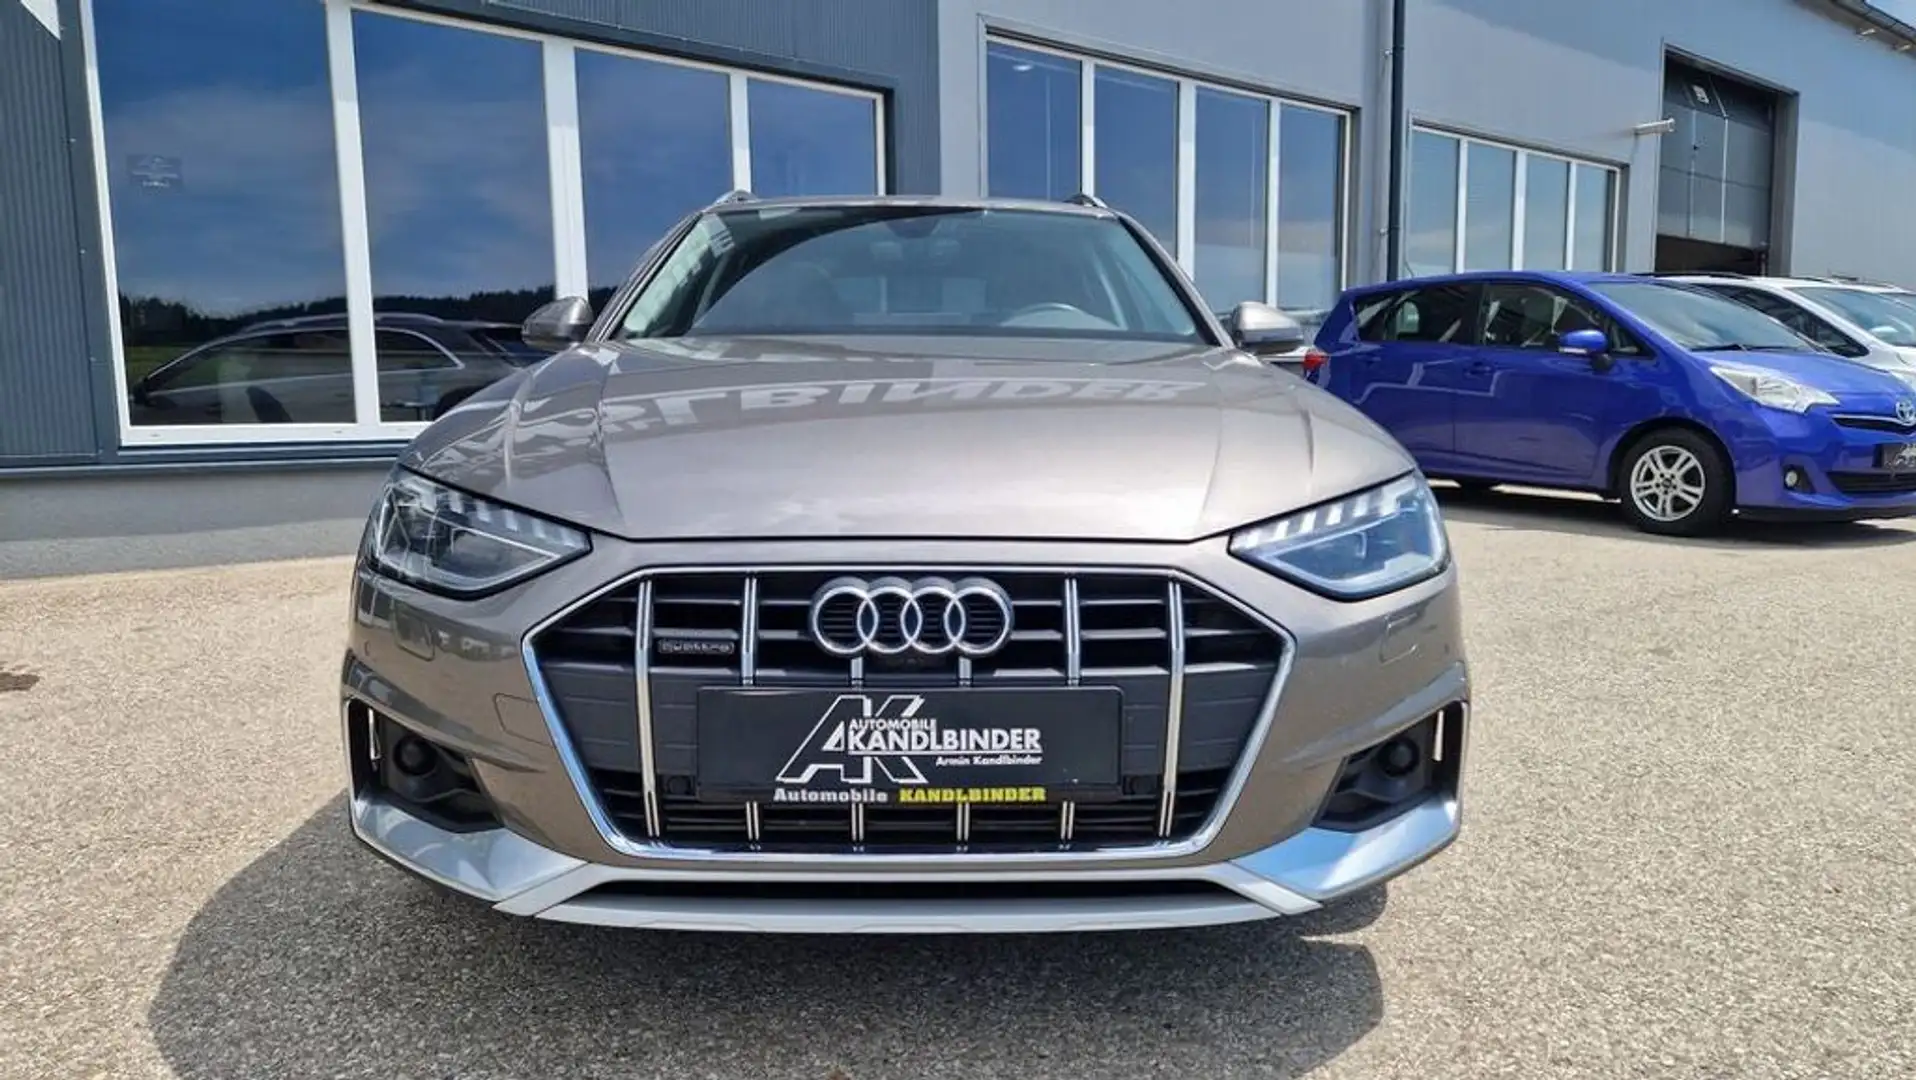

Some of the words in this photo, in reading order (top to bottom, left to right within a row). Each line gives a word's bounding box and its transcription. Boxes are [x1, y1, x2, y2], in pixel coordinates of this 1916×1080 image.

[849, 719, 937, 730] AUTOMOBILE
[848, 723, 1041, 751] KANDLBINDER
[936, 756, 970, 767] Armin
[973, 754, 1042, 766] Kandlbinder
[773, 786, 888, 802] Automobile
[899, 786, 1046, 802] KANDLBINDER
